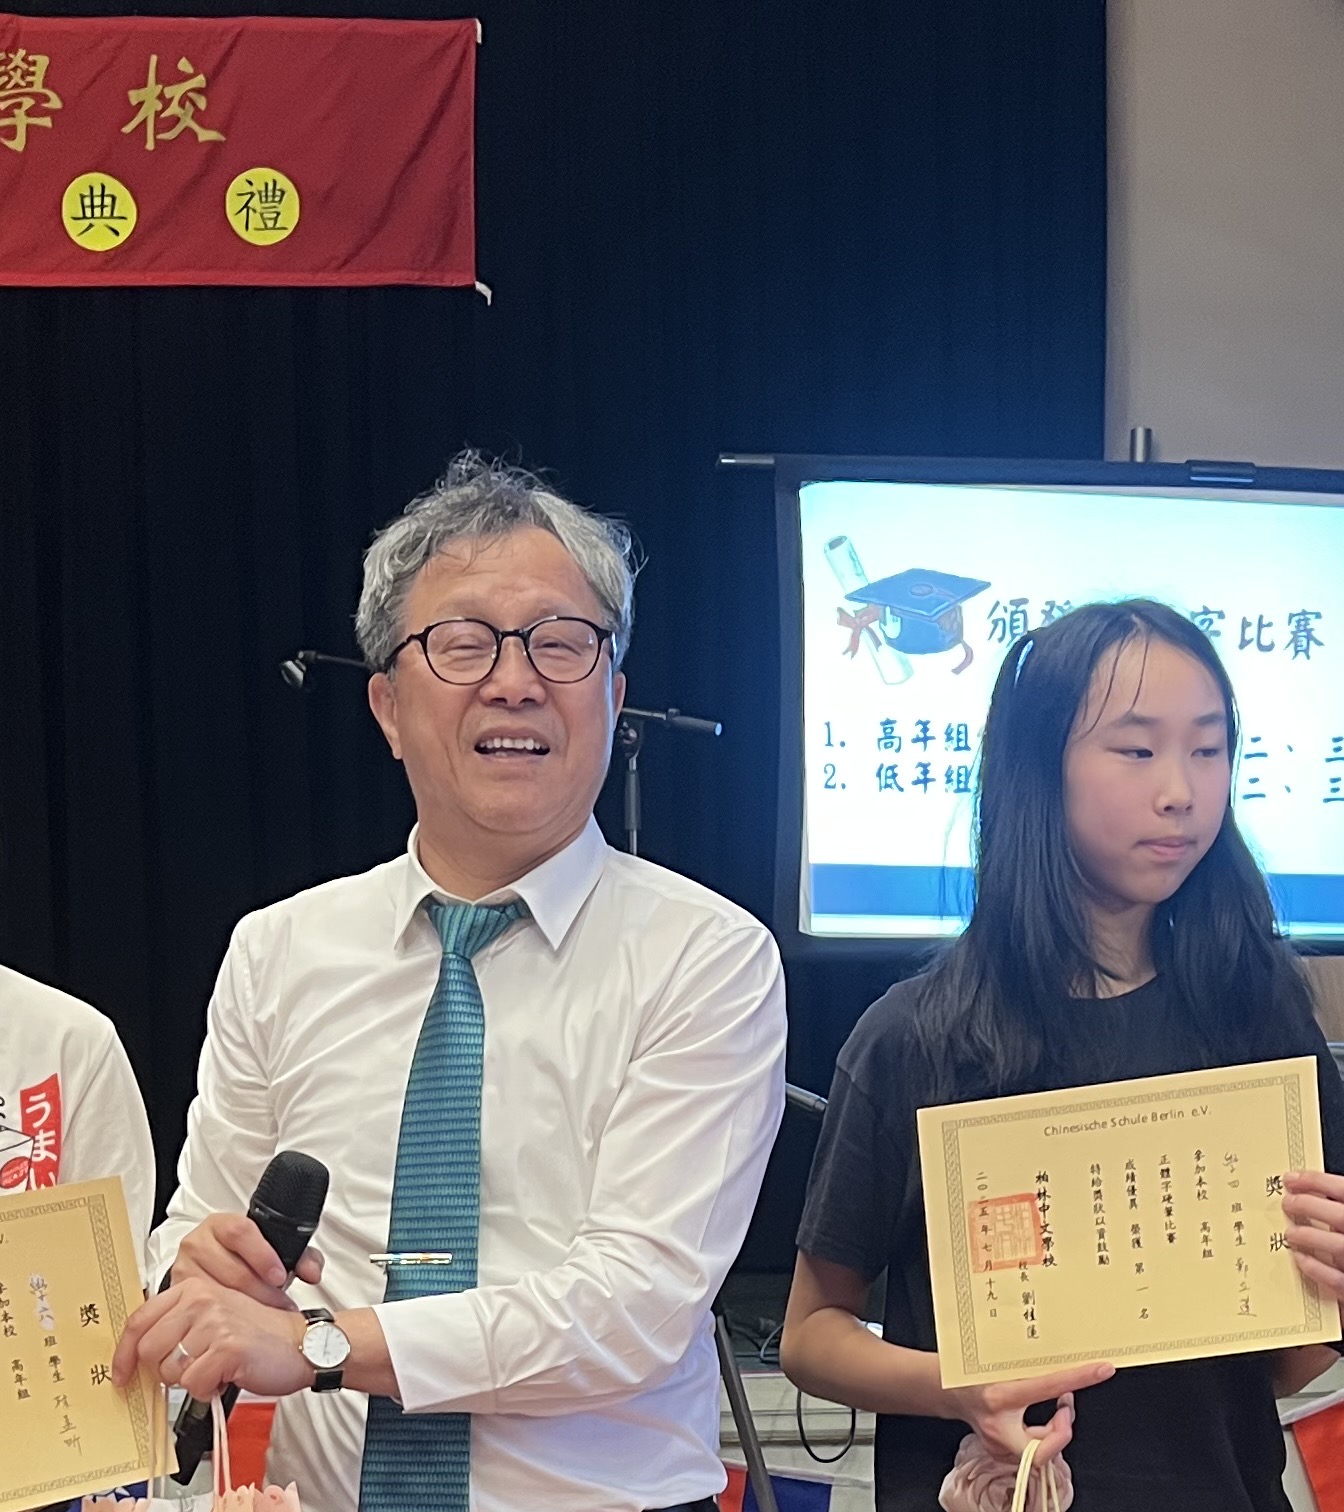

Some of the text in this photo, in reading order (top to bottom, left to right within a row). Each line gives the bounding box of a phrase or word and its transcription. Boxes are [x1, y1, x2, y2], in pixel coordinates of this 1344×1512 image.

[877, 718, 972, 753] 高年組
[876, 762, 972, 794] 低年組
[26, 1092, 58, 1191] うまい
[1044, 1119, 1108, 1137] Chinesische
[1110, 1113, 1149, 1128] Schule
[1151, 1110, 1185, 1123] Berlin
[1035, 1170, 1059, 1269] 柏林中文學校
[79, 1302, 112, 1387] 獎狀
